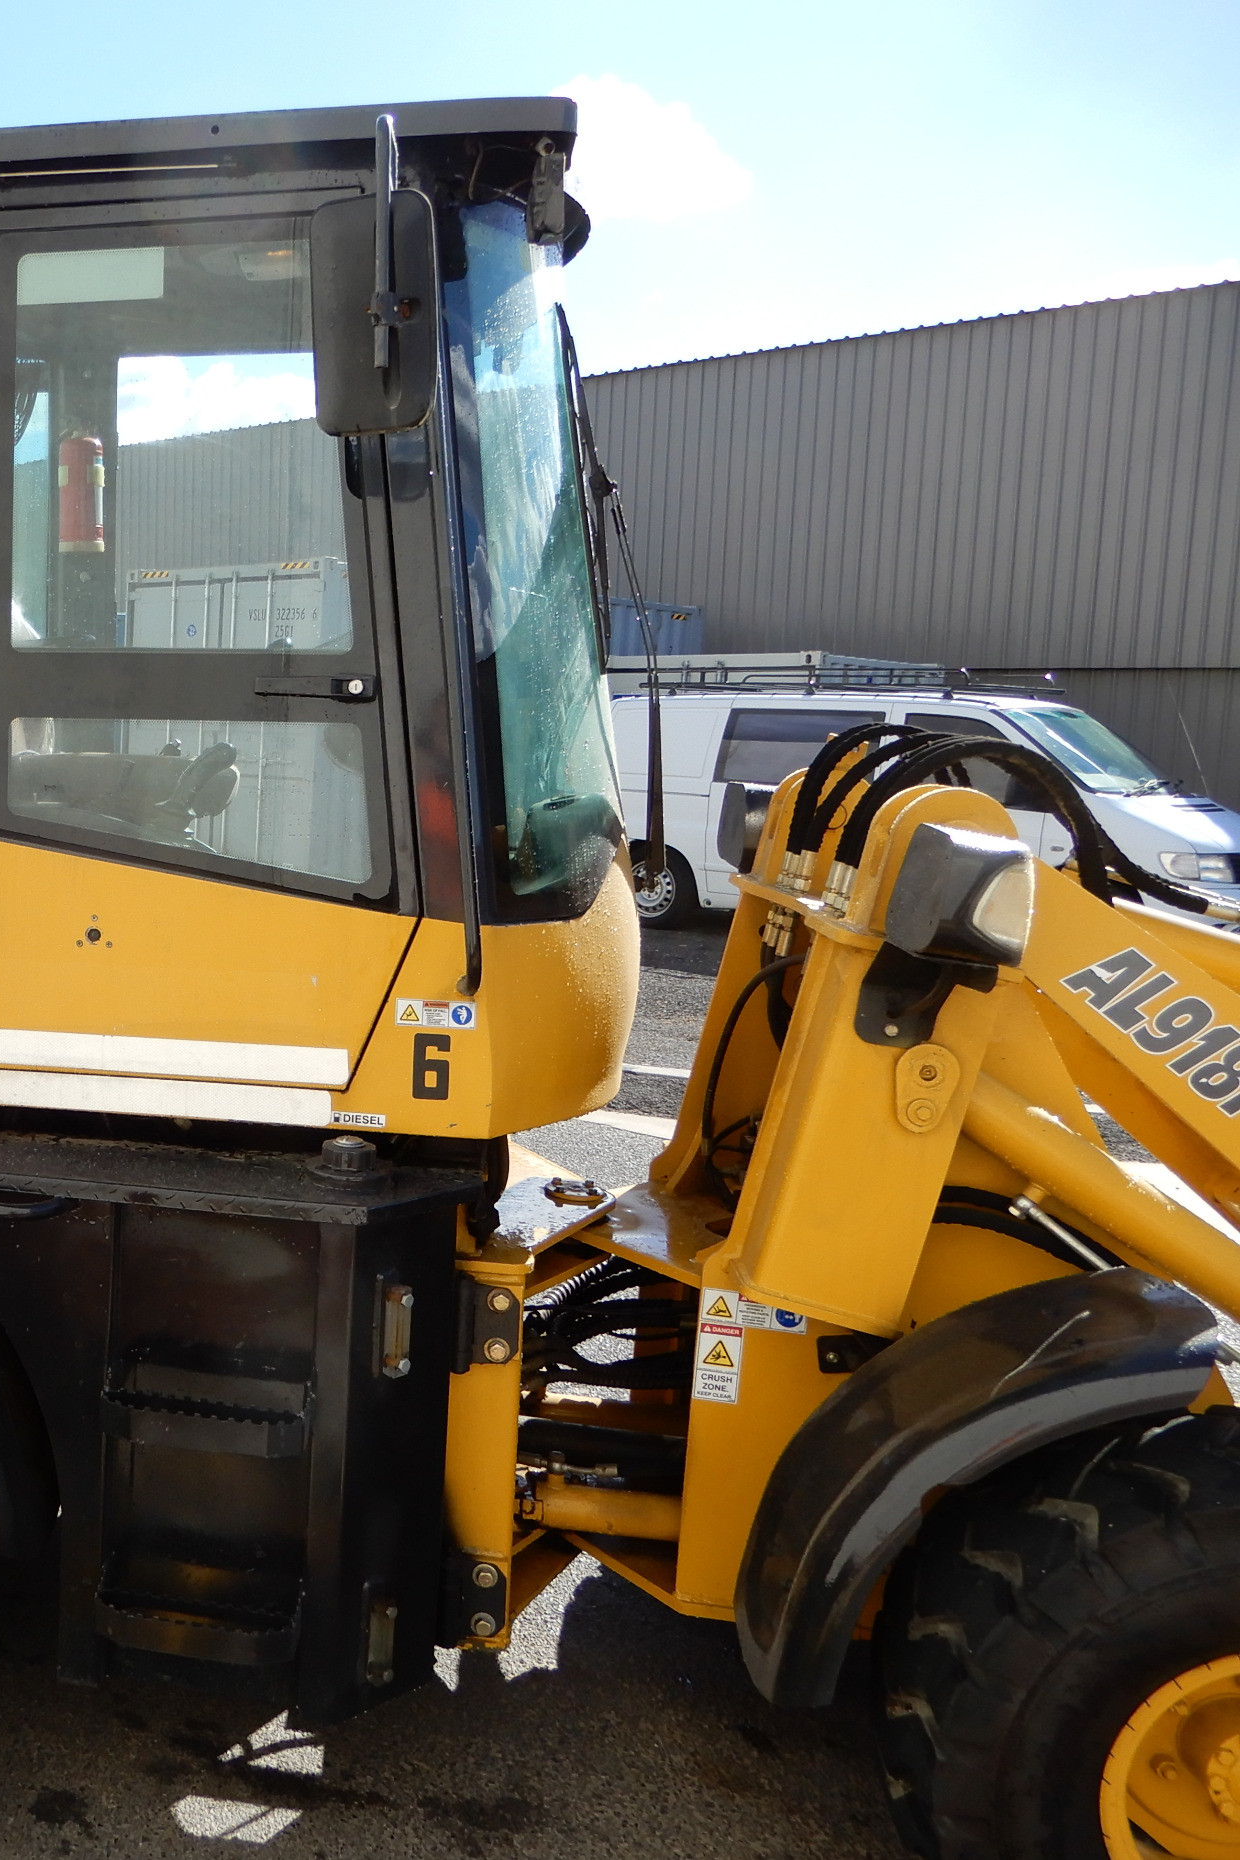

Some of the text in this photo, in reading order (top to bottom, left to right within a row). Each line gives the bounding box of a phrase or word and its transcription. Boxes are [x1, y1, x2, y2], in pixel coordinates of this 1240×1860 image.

[248, 607, 318, 621] VSLU 322356 6
[275, 625, 294, 638] 25G1
[1059, 946, 1240, 1118] AL918
[412, 1033, 451, 1100] 6
[343, 1113, 384, 1126] DIESEL
[712, 1326, 740, 1335] DANGER
[700, 1373, 733, 1384] CRUSH
[702, 1382, 729, 1393] ZONE.
